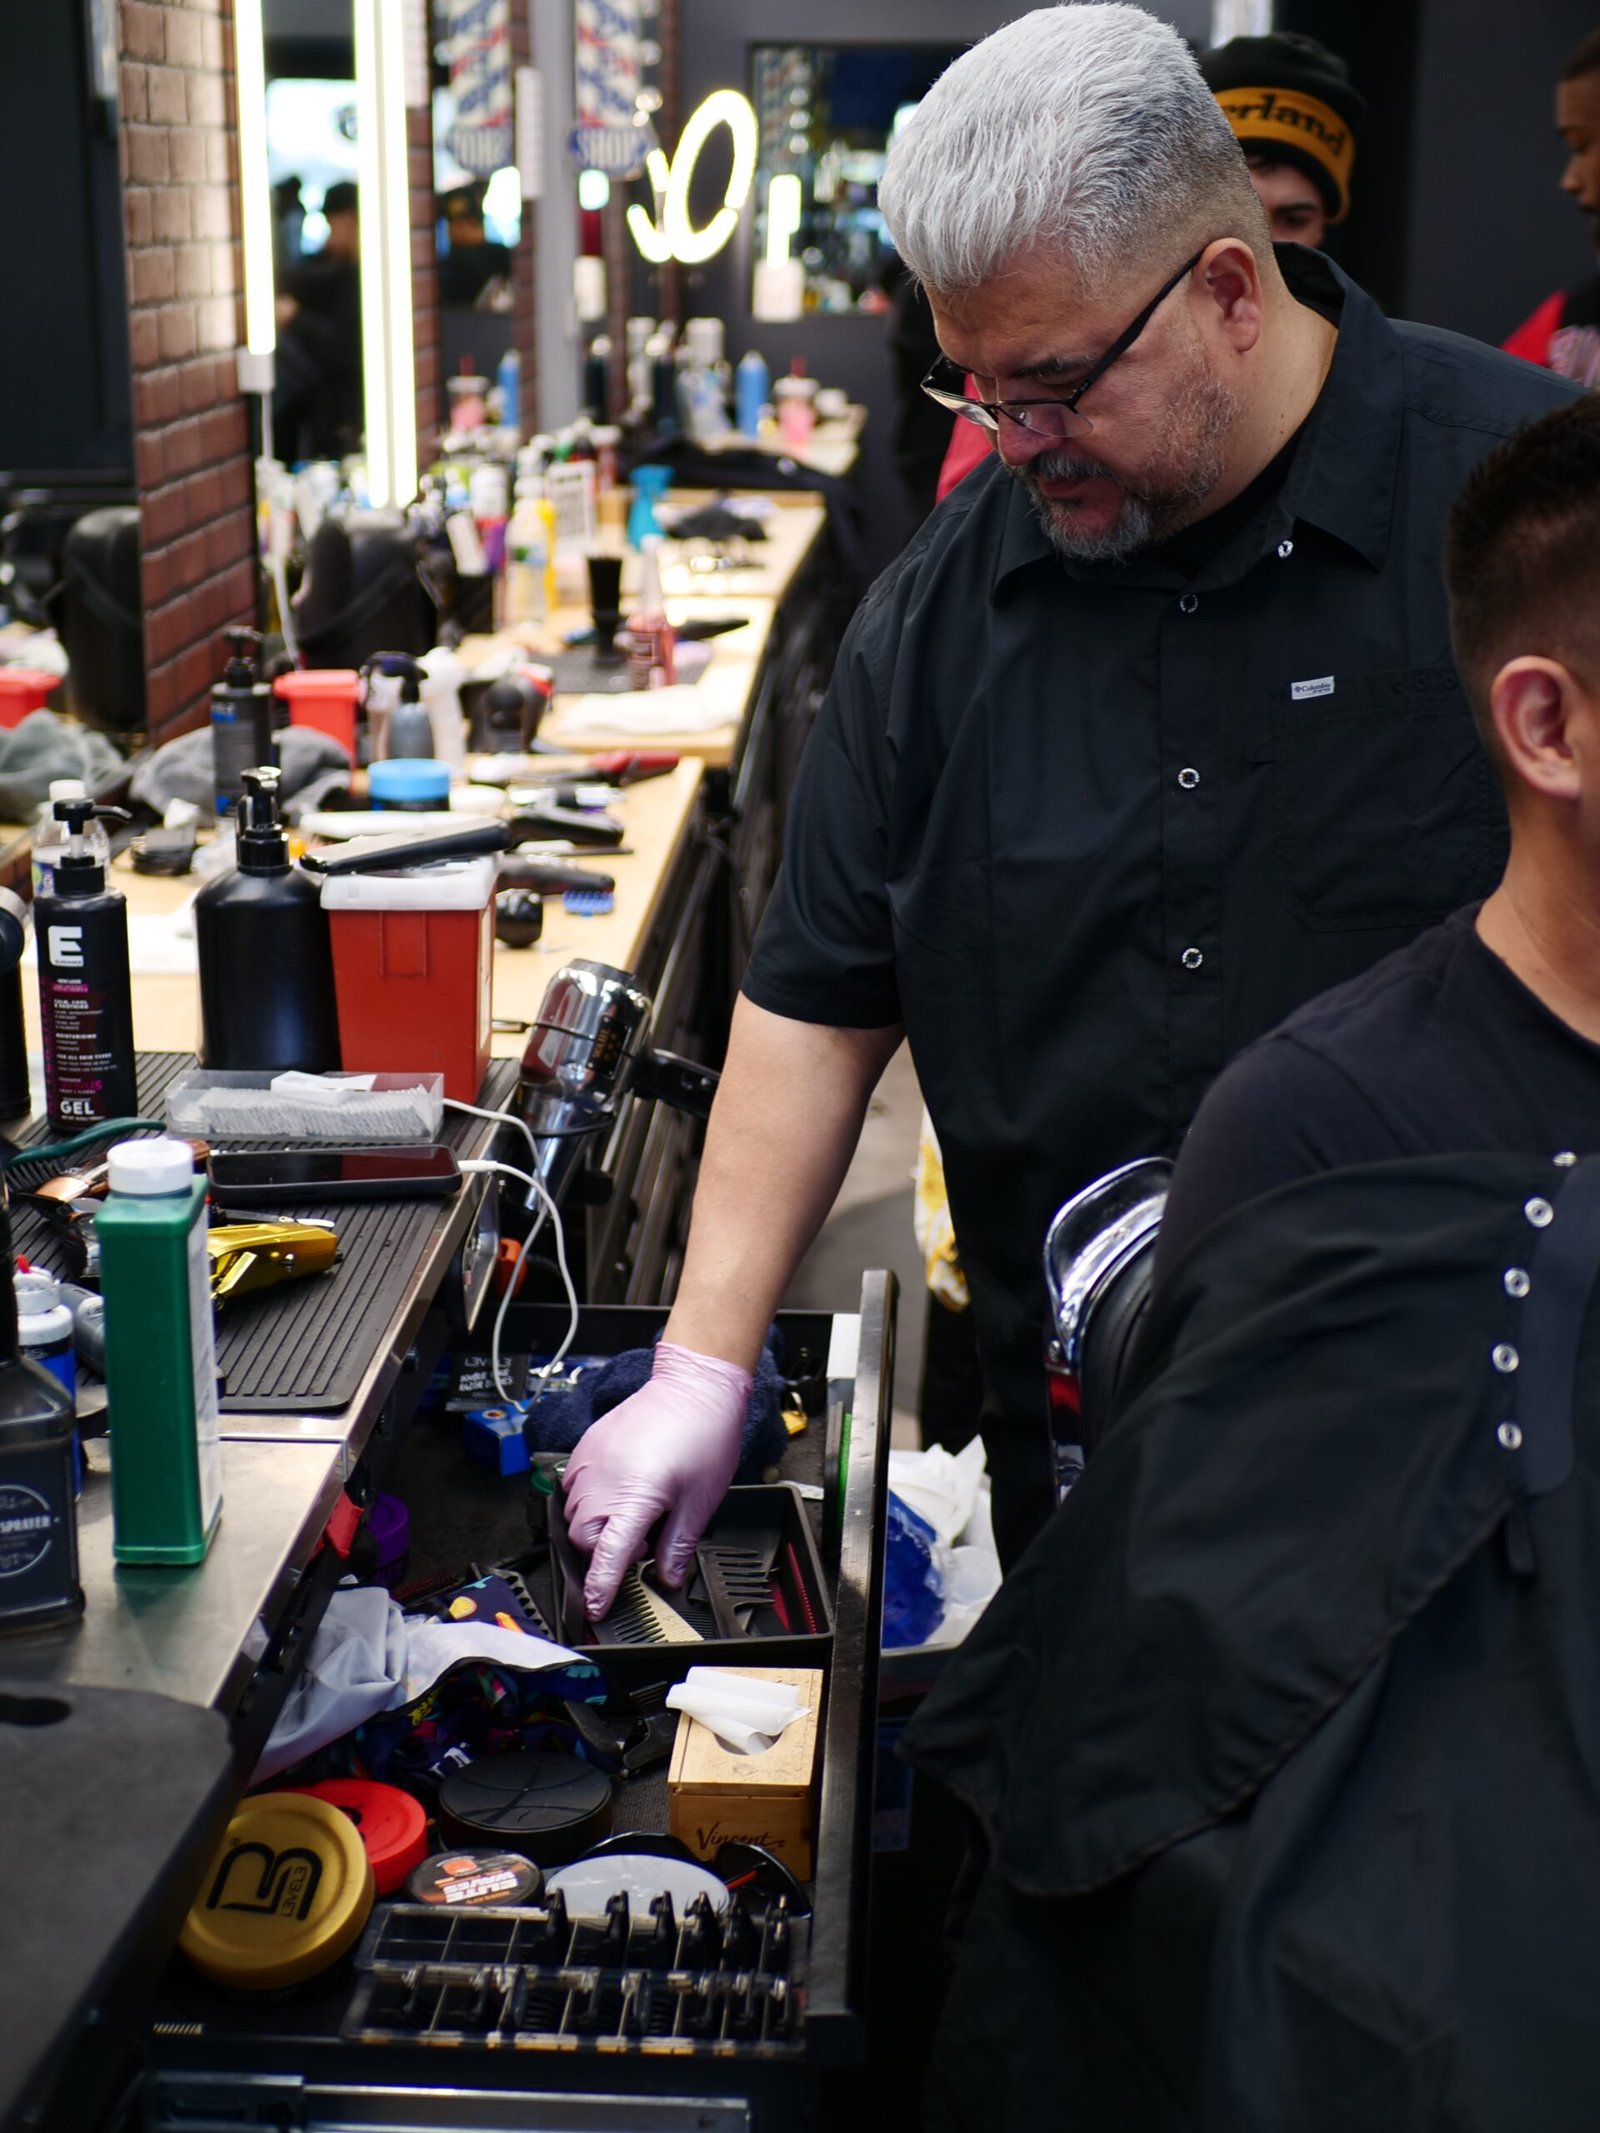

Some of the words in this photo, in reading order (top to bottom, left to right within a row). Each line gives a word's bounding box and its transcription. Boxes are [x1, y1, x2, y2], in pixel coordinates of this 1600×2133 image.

[60, 1101, 94, 1115] GEL
[464, 1357, 511, 1368] L3VL3
[696, 1821, 786, 1851] Vincent
